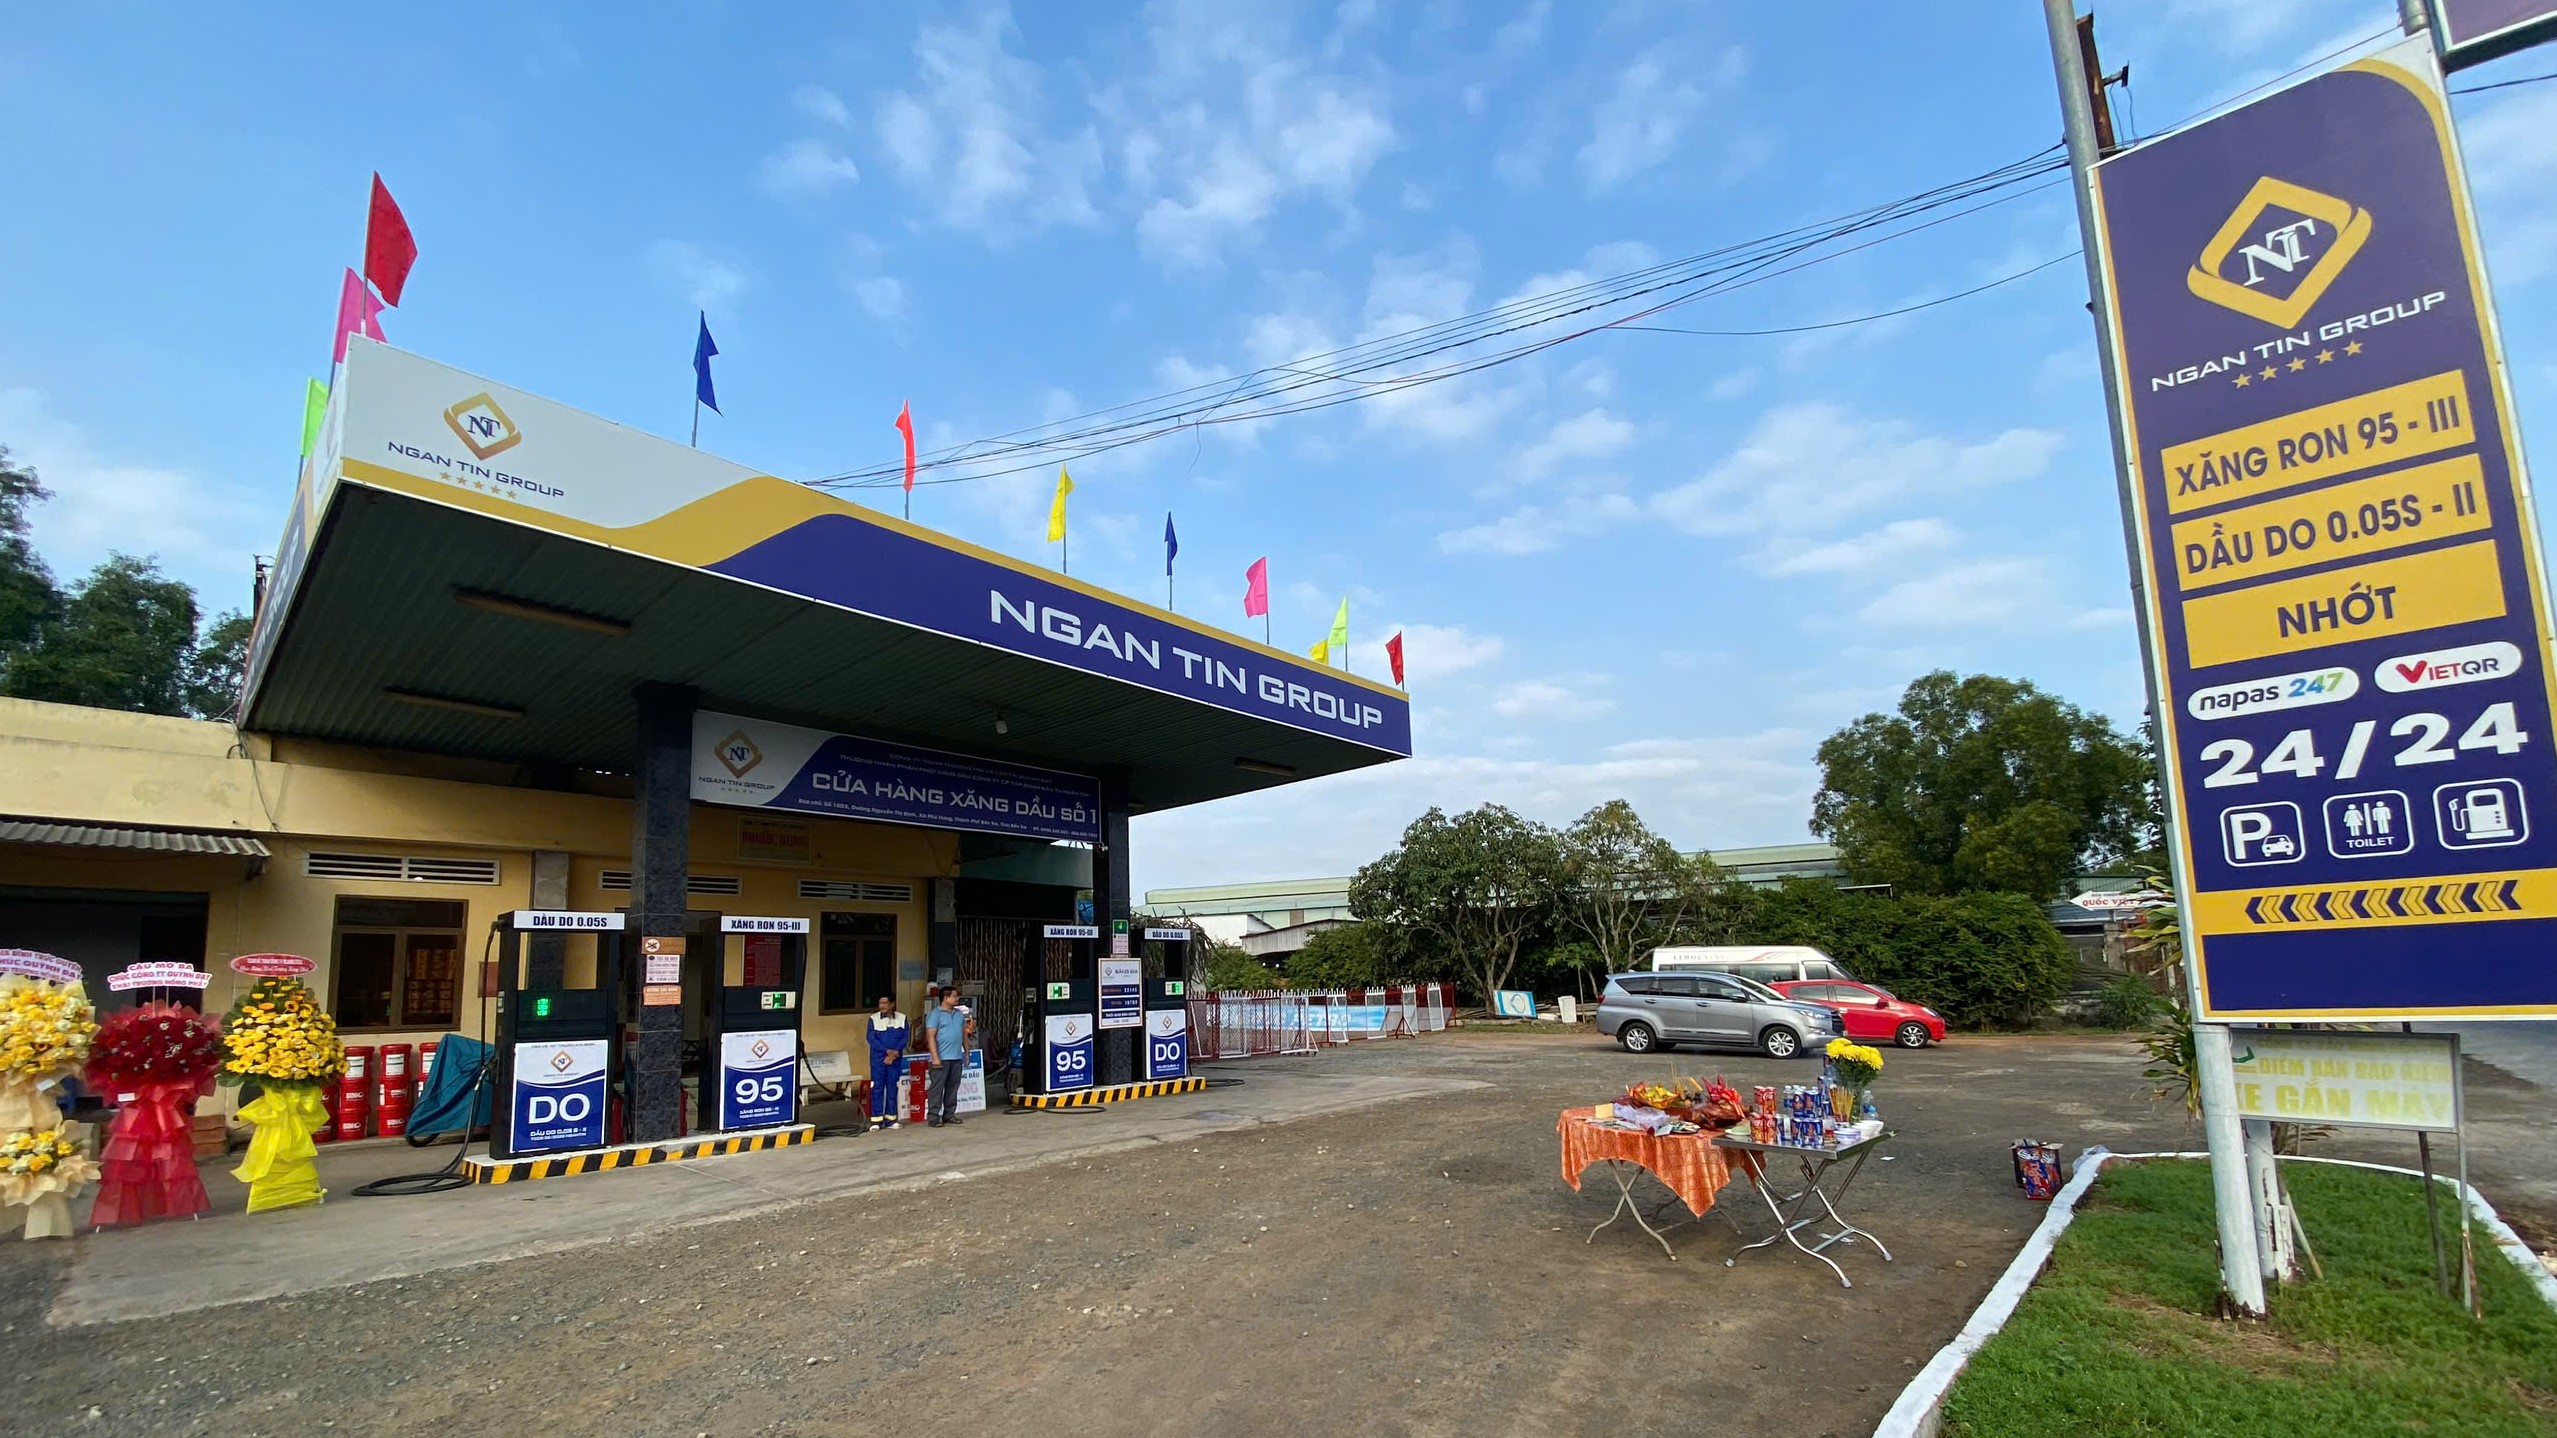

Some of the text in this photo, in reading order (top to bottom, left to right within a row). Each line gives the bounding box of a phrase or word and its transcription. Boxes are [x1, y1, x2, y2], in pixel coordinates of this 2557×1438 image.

[2238, 219, 2316, 287] NT
[2151, 291, 2446, 391] NGAN TIN GROUP
[388, 441, 565, 498] NGAN TIN GROUP
[2175, 446, 2269, 496] XĂNG
[2277, 424, 2348, 470] RON
[2357, 412, 2399, 450] 95
[2185, 521, 2254, 574] DẦU
[2264, 518, 2317, 557] DO
[2327, 494, 2422, 543] 0.05S
[2276, 581, 2397, 638] NHỚT
[990, 588, 1383, 729] NGAN TIN GROUP
[2395, 657, 2499, 684] VIETQR
[2199, 672, 2345, 712] napas 247
[698, 776, 775, 790] NGAN TIN GROUP
[812, 770, 1097, 824] CỬA HÀNG XĂNG DẦU SỐ 1
[2230, 812, 2272, 860] P
[2346, 836, 2395, 849] TOILET
[559, 916, 573, 926] DO
[577, 917, 607, 927] 0.05S
[757, 920, 774, 930] RON
[1056, 1050, 1086, 1071] 95
[1155, 1042, 1180, 1061] DO
[528, 1093, 591, 1124] DO
[735, 1076, 784, 1104] 95
